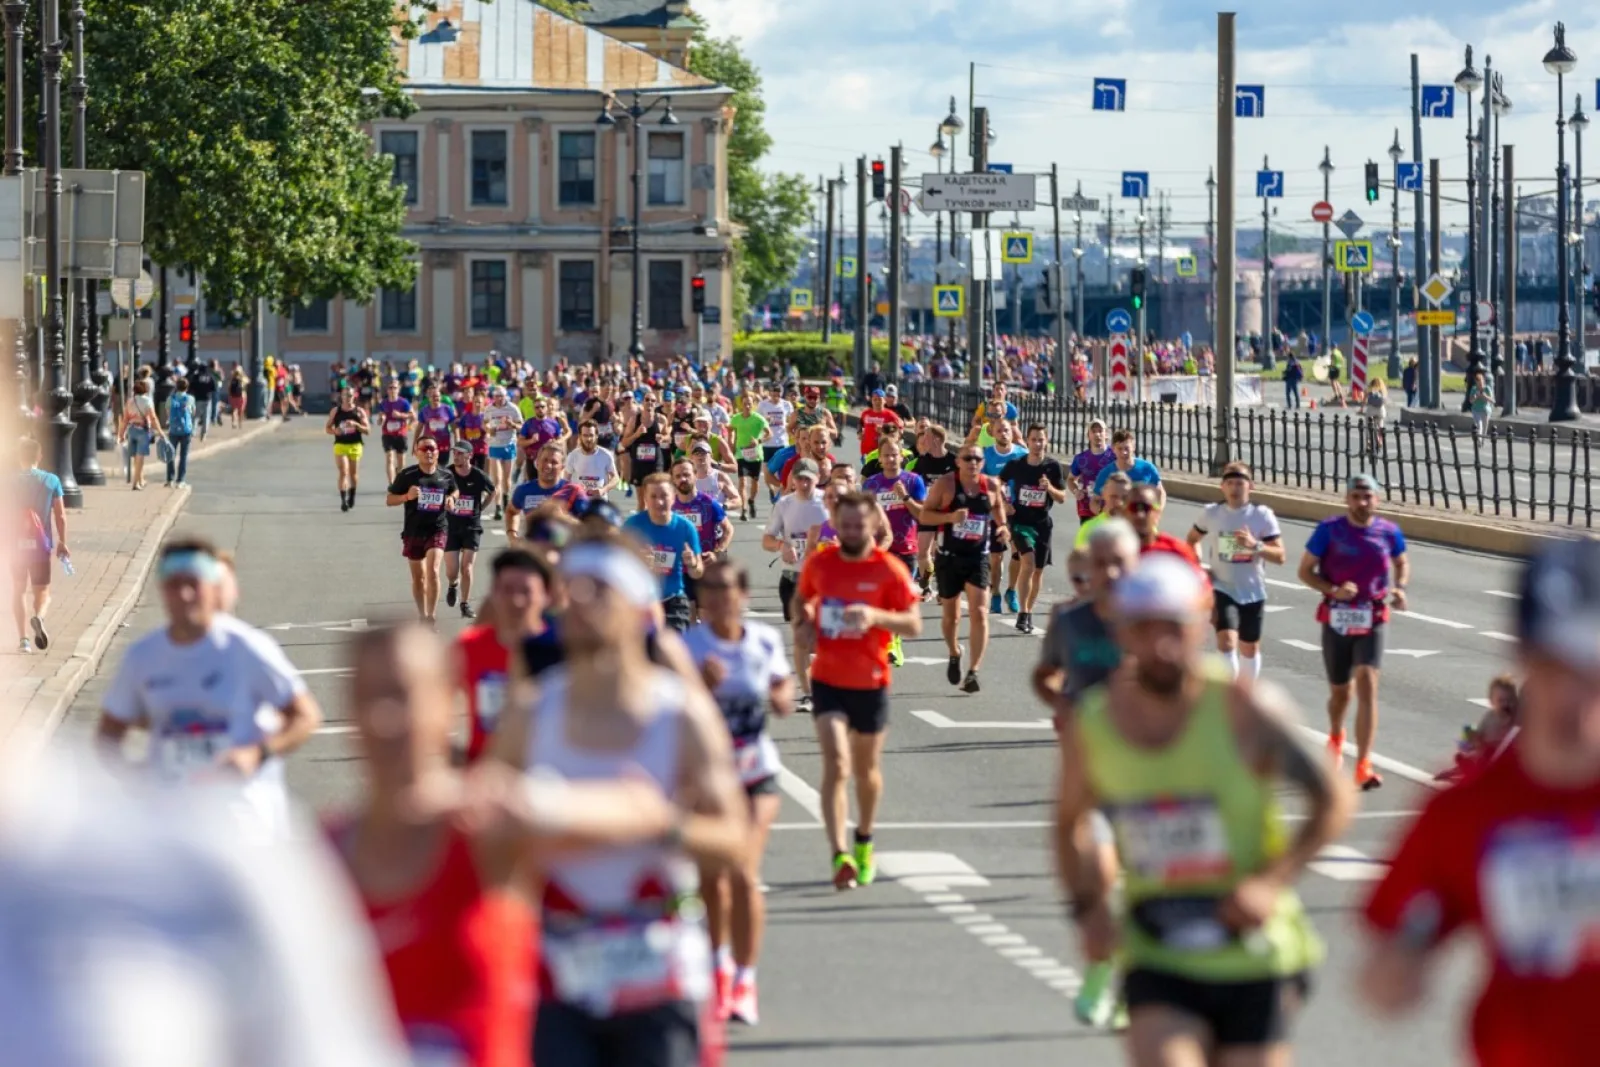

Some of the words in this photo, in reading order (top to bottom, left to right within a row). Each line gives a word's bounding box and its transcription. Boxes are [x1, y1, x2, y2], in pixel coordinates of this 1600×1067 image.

[944, 176, 1006, 186] КАДЕТСКАЯ
[944, 199, 984, 208] ТУЧКОВ
[988, 200, 1012, 208] мост
[421, 493, 441, 501] 3910
[1022, 490, 1043, 499] 4627
[1335, 611, 1366, 623] 3286
